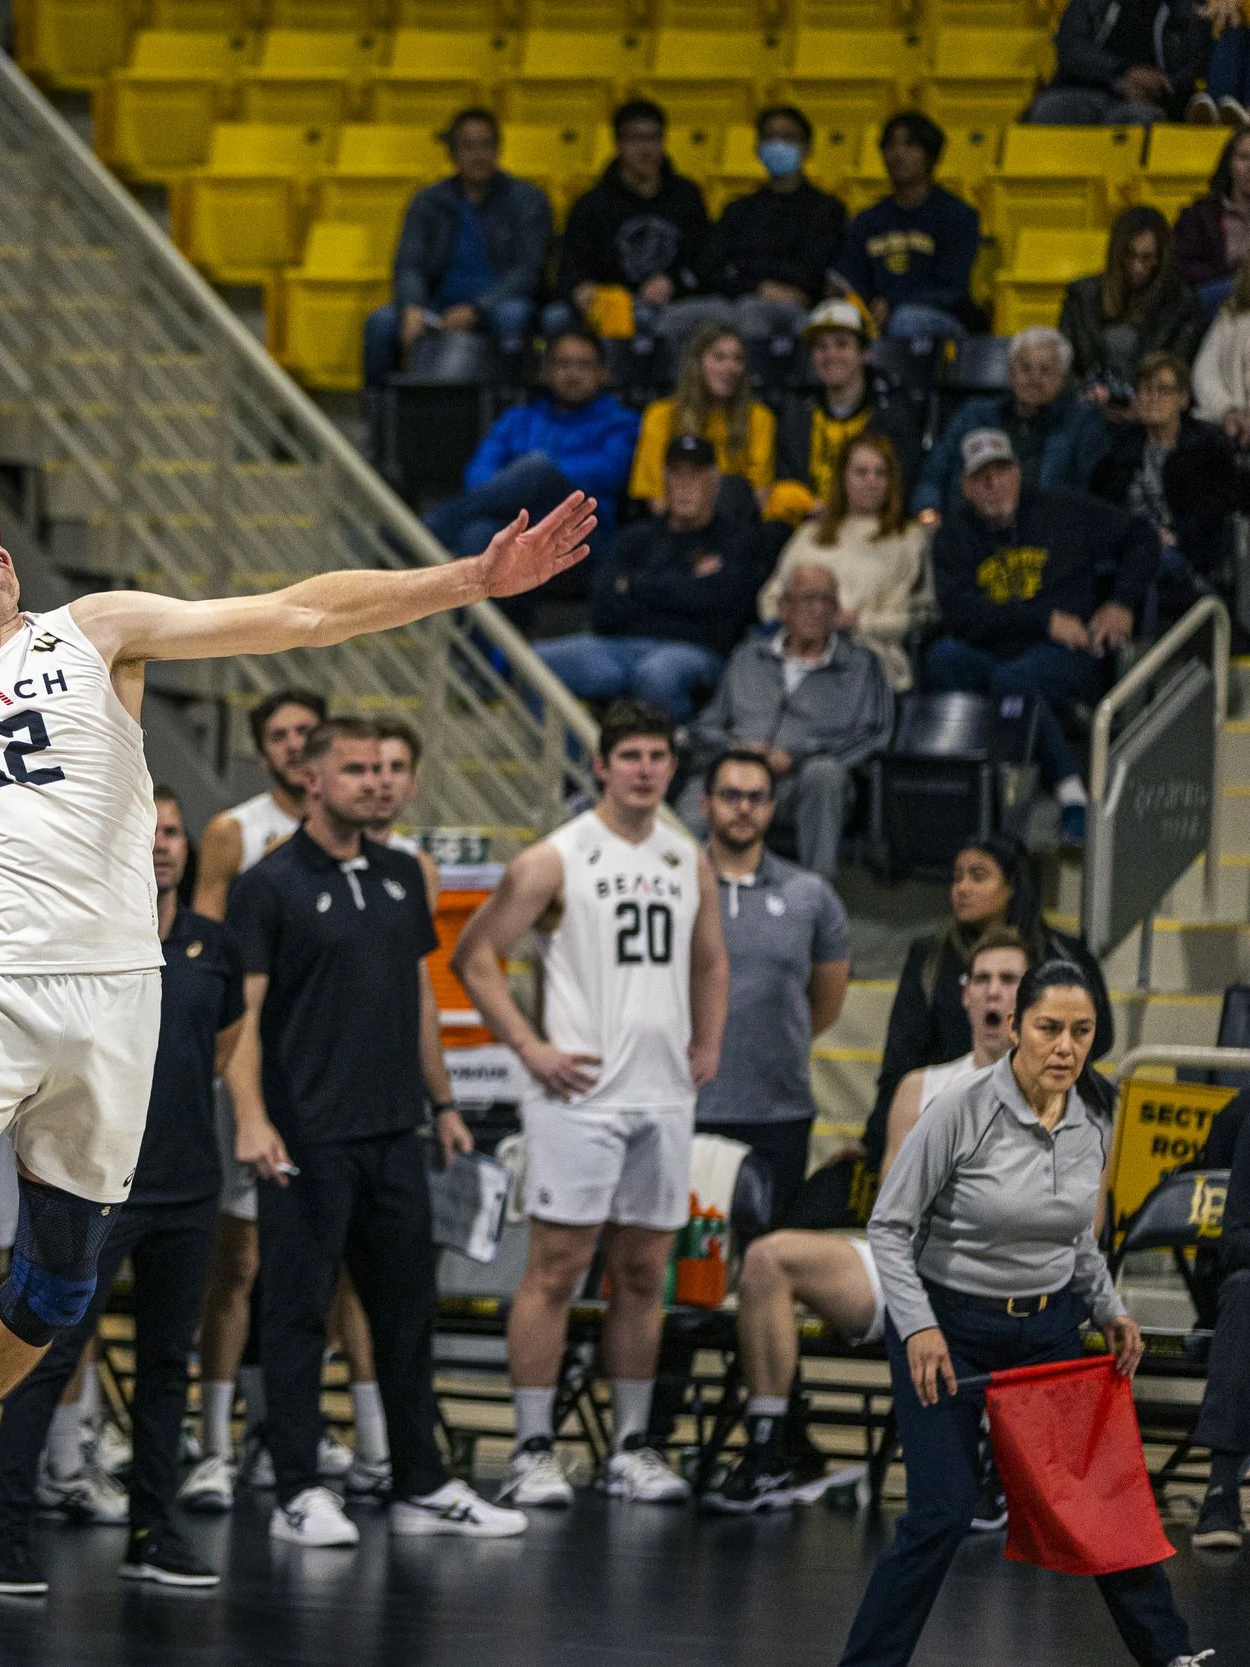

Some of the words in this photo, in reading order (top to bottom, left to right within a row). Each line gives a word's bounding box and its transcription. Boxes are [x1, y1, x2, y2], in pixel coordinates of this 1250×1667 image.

[596, 873, 683, 901] BEACH
[616, 900, 673, 964] 20
[1140, 1101, 1216, 1131] SECT
